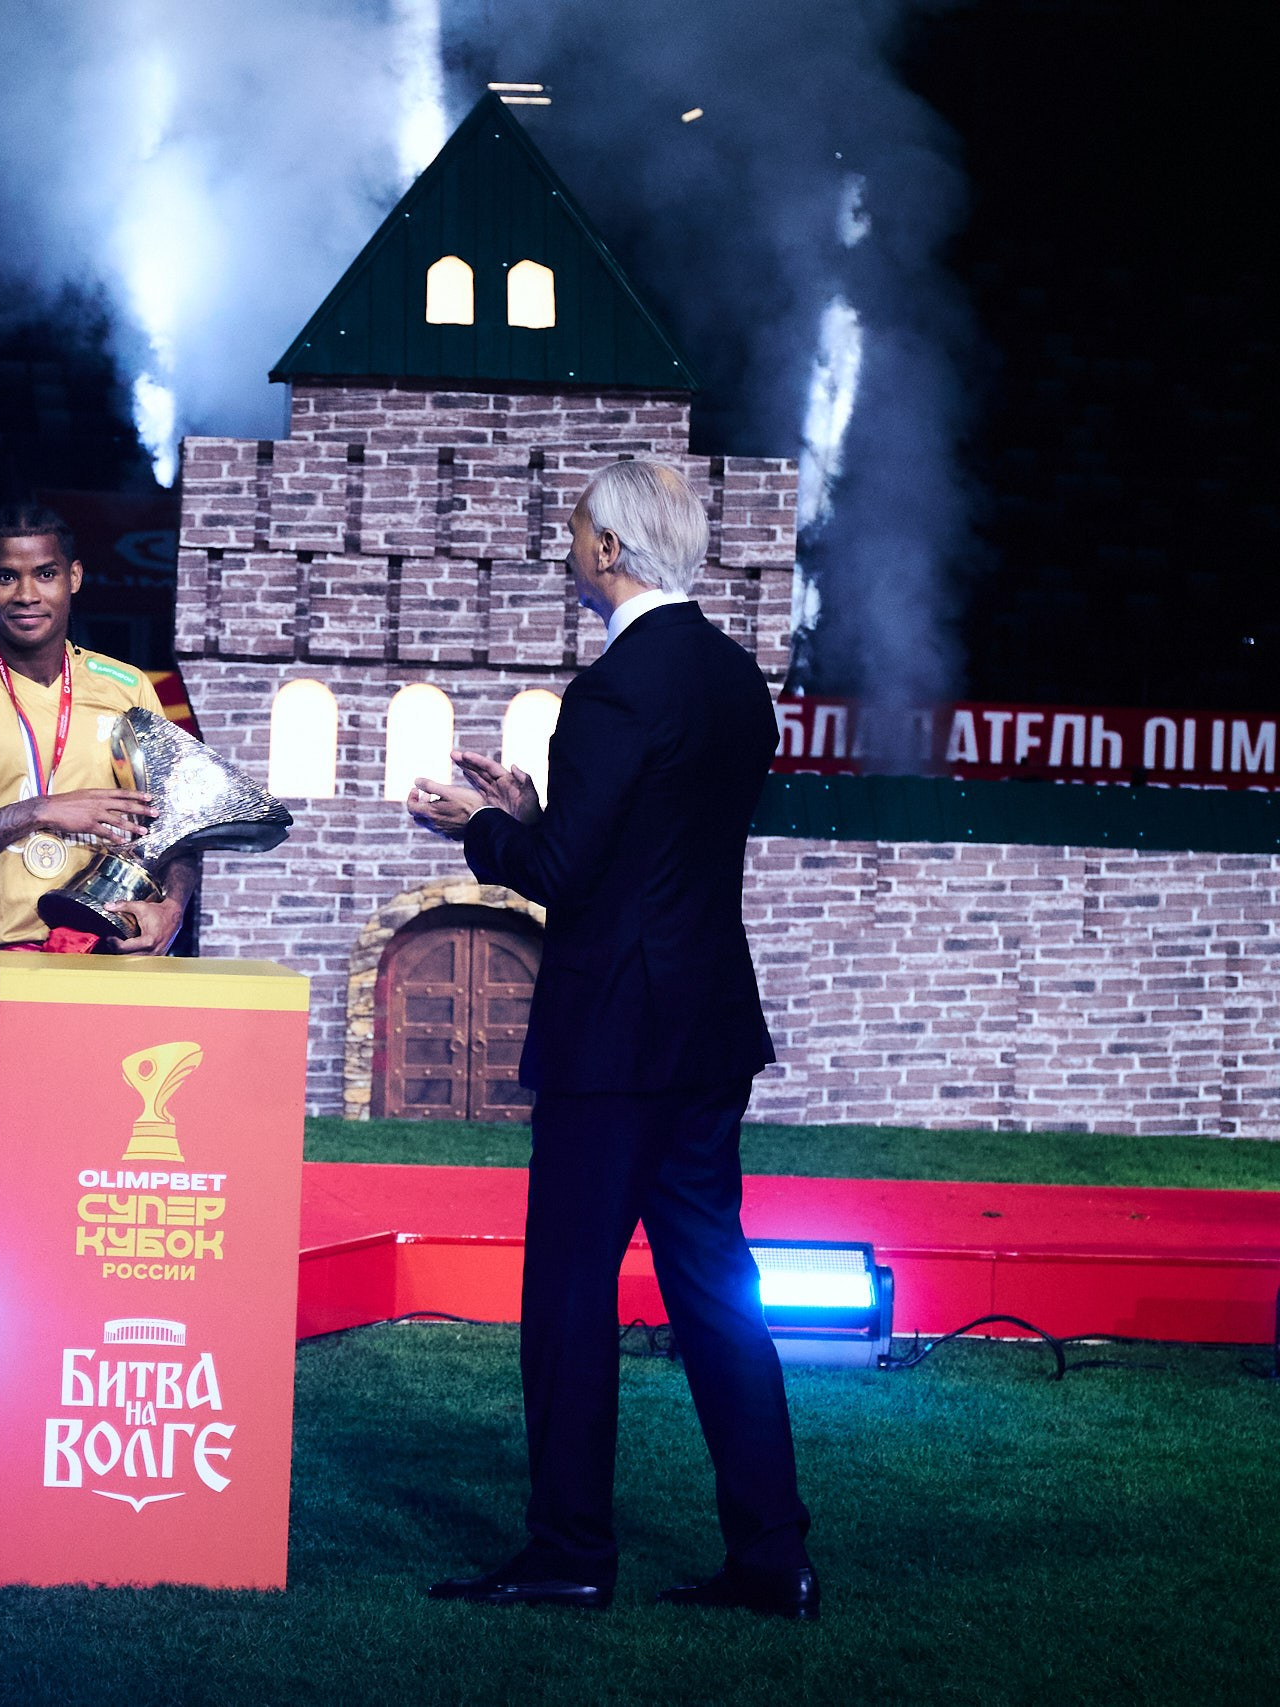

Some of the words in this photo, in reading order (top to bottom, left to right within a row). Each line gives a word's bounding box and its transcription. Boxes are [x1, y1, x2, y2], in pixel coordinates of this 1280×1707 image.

[78, 1169, 226, 1192] OLIMPBET
[77, 1193, 226, 1227] СУПЕР
[75, 1225, 224, 1260] КУБОК
[102, 1262, 196, 1281] РОССИИ
[60, 1348, 223, 1411] БИТВА
[125, 1400, 157, 1426] НА
[43, 1417, 237, 1494] ВОЛГЕ
